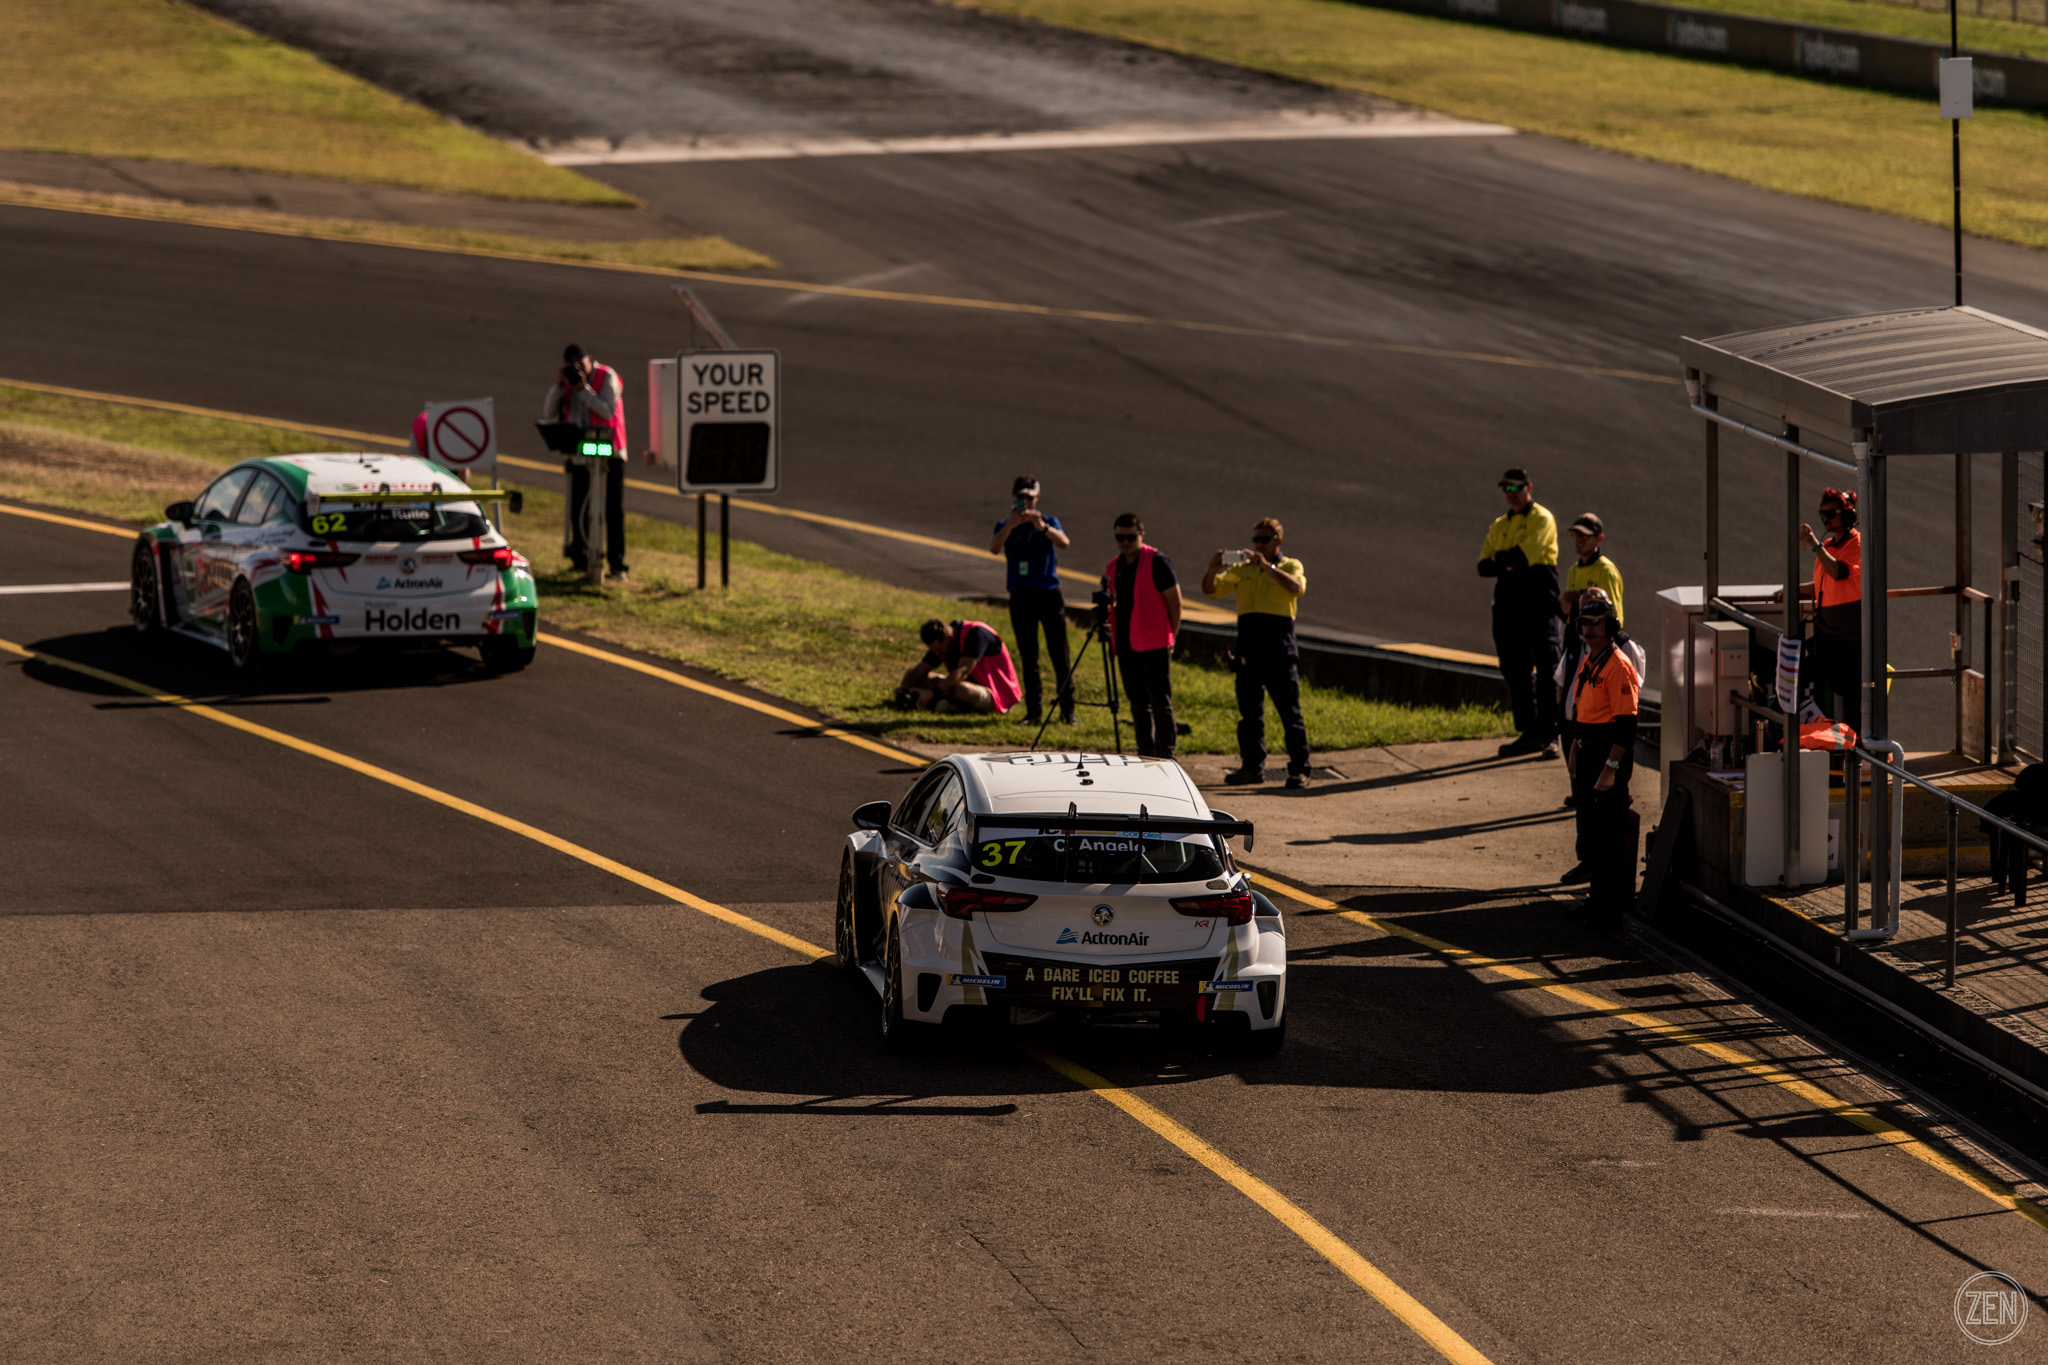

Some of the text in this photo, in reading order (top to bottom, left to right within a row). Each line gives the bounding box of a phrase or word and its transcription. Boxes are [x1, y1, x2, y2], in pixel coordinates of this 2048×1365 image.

[692, 363, 763, 385] YOUR
[687, 391, 771, 413] SPEED
[312, 513, 348, 535] 62
[394, 578, 443, 589] ActronAir
[365, 608, 460, 631] Holden
[981, 840, 1026, 867] 37
[1078, 837, 1146, 855] Angelo
[1194, 920, 1210, 928] KR
[1081, 931, 1150, 946] ActronAir
[962, 977, 1001, 986] MICHELIN
[1025, 968, 1180, 985] A DARE ICED COFFEE
[1051, 986, 1151, 1003] FIX'LL FIX IT.
[1215, 983, 1252, 992] MICHELIN
